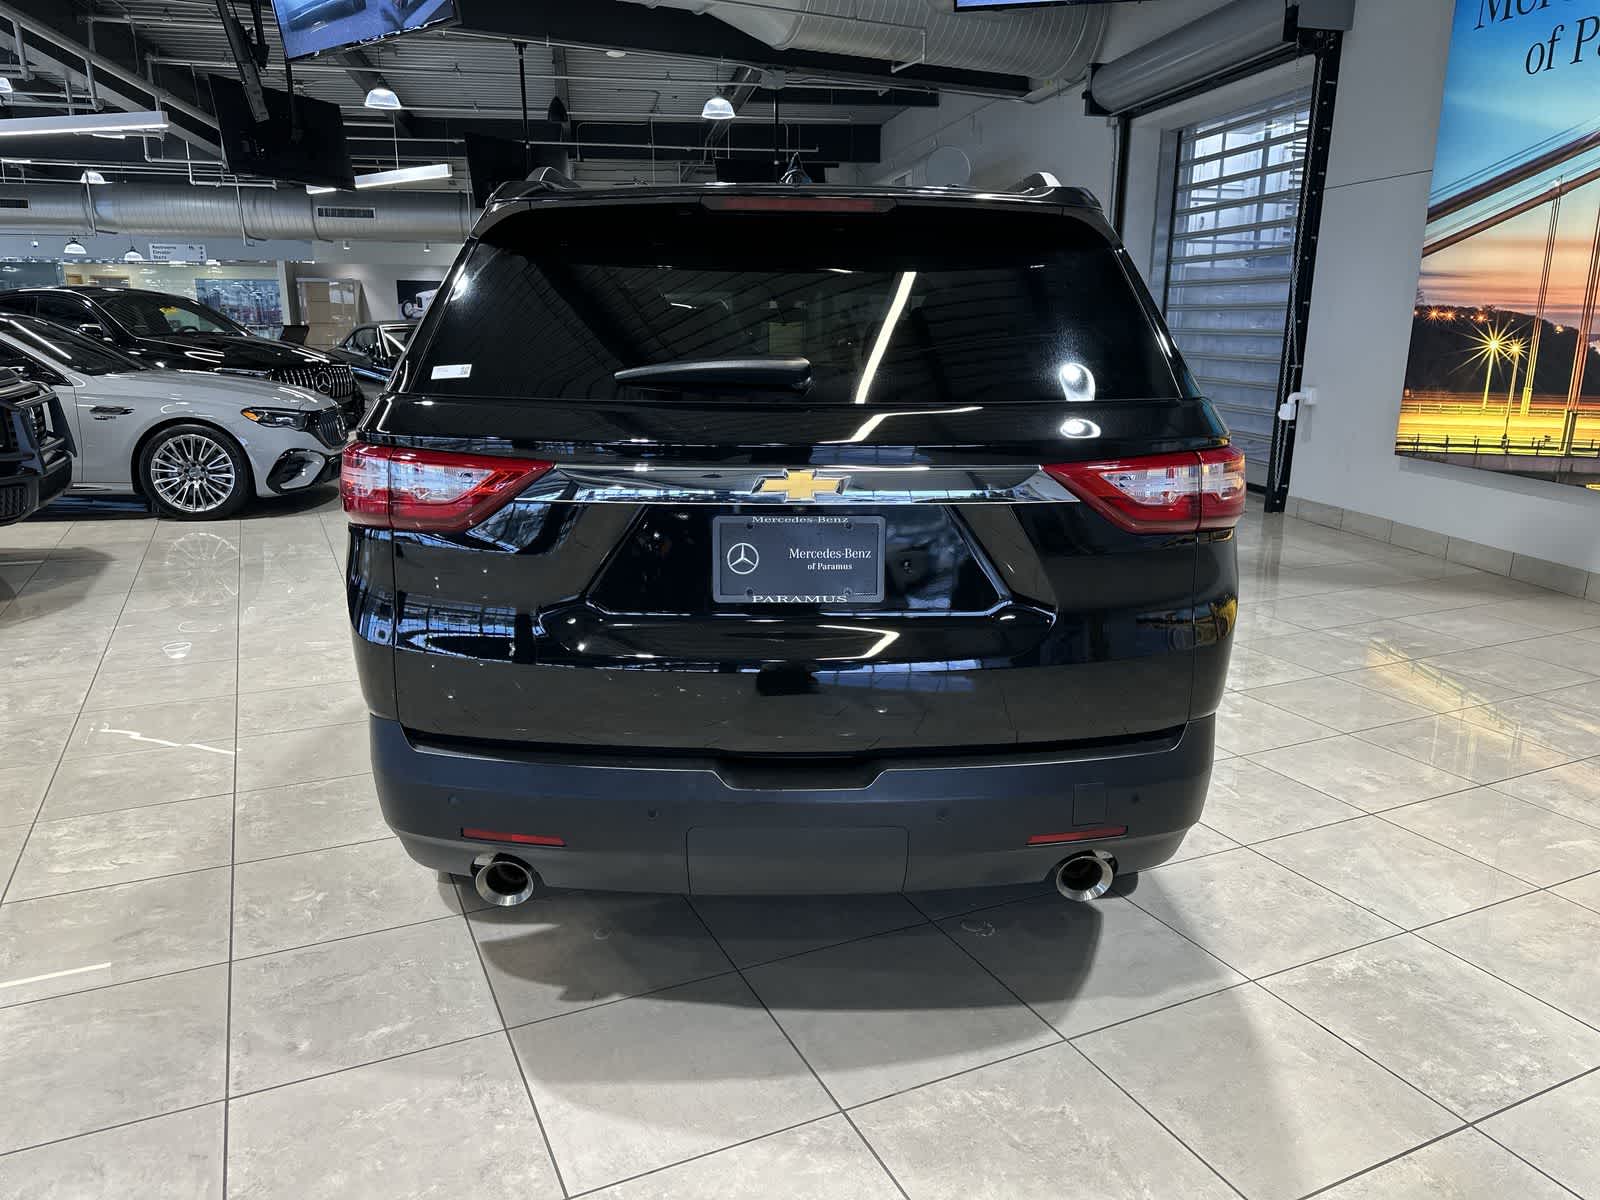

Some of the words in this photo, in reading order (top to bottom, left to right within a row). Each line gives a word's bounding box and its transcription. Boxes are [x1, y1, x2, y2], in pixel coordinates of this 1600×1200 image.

[1525, 24, 1565, 75] of
[1569, 15, 1600, 65] P
[789, 548, 872, 559] Mercedes-Benz
[807, 562, 817, 570] of
[752, 595, 848, 603] PARAMUS
